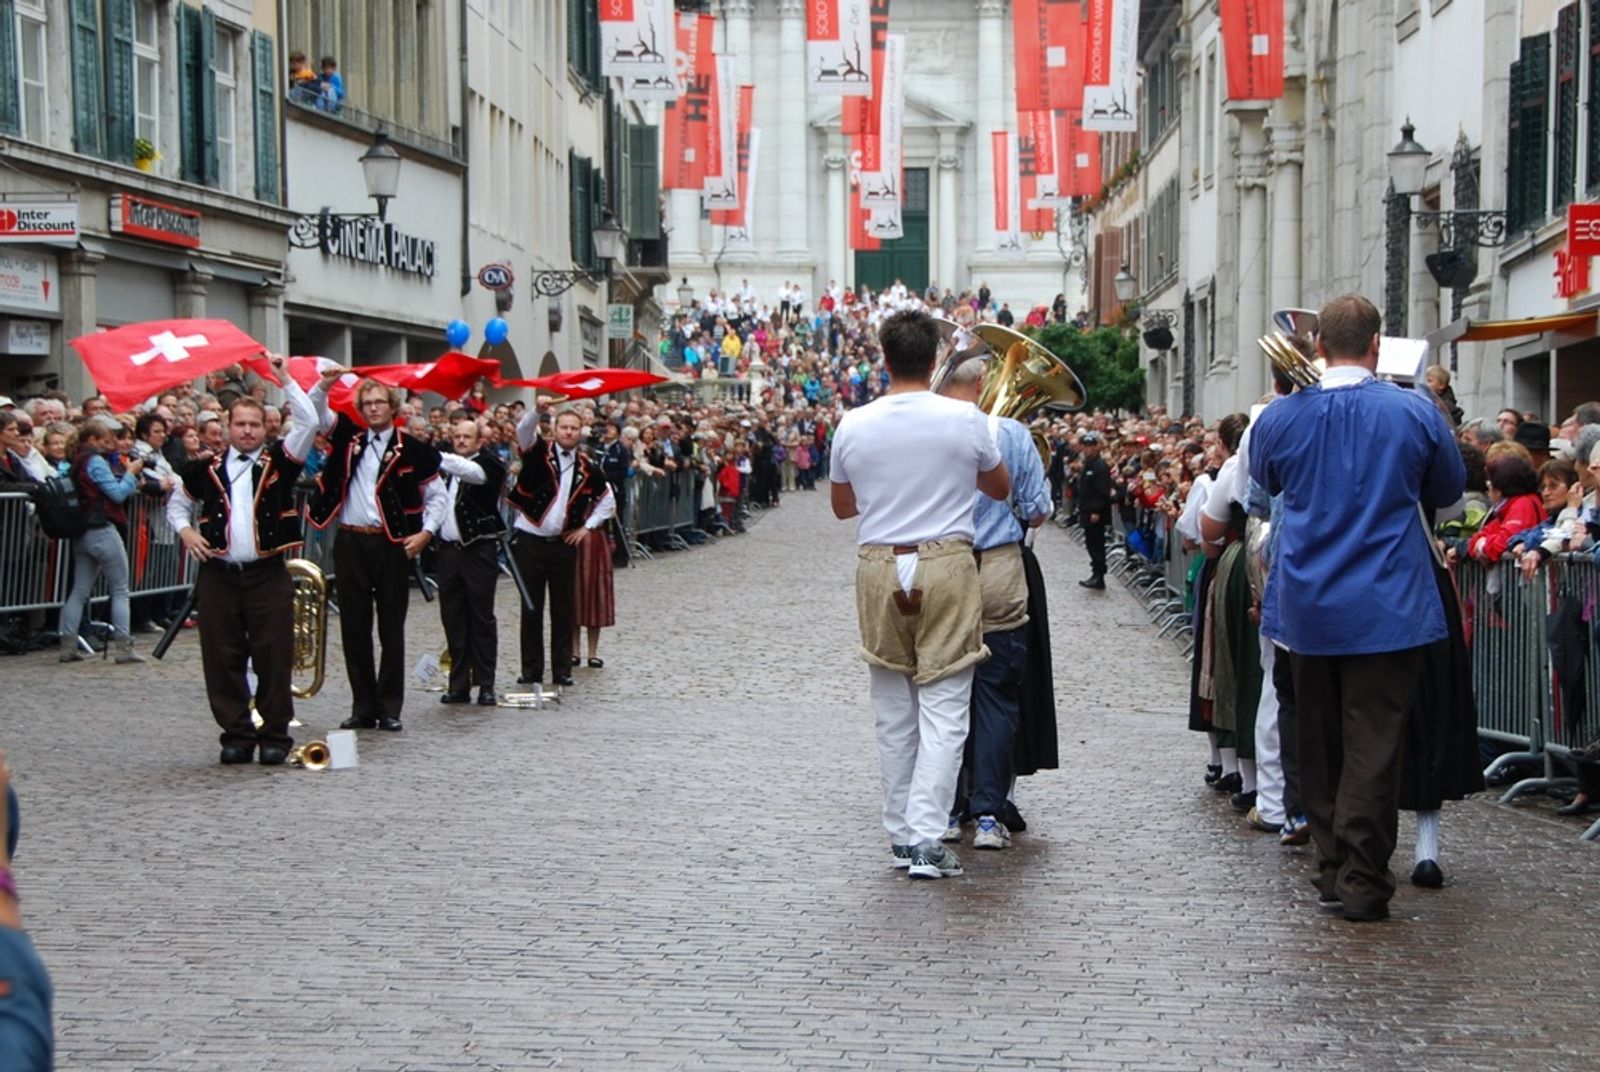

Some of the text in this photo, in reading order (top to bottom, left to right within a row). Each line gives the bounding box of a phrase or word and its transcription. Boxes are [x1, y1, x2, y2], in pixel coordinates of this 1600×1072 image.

[815, 0, 829, 36] SOLO
[17, 209, 50, 220] Inter
[17, 221, 75, 231] Discount
